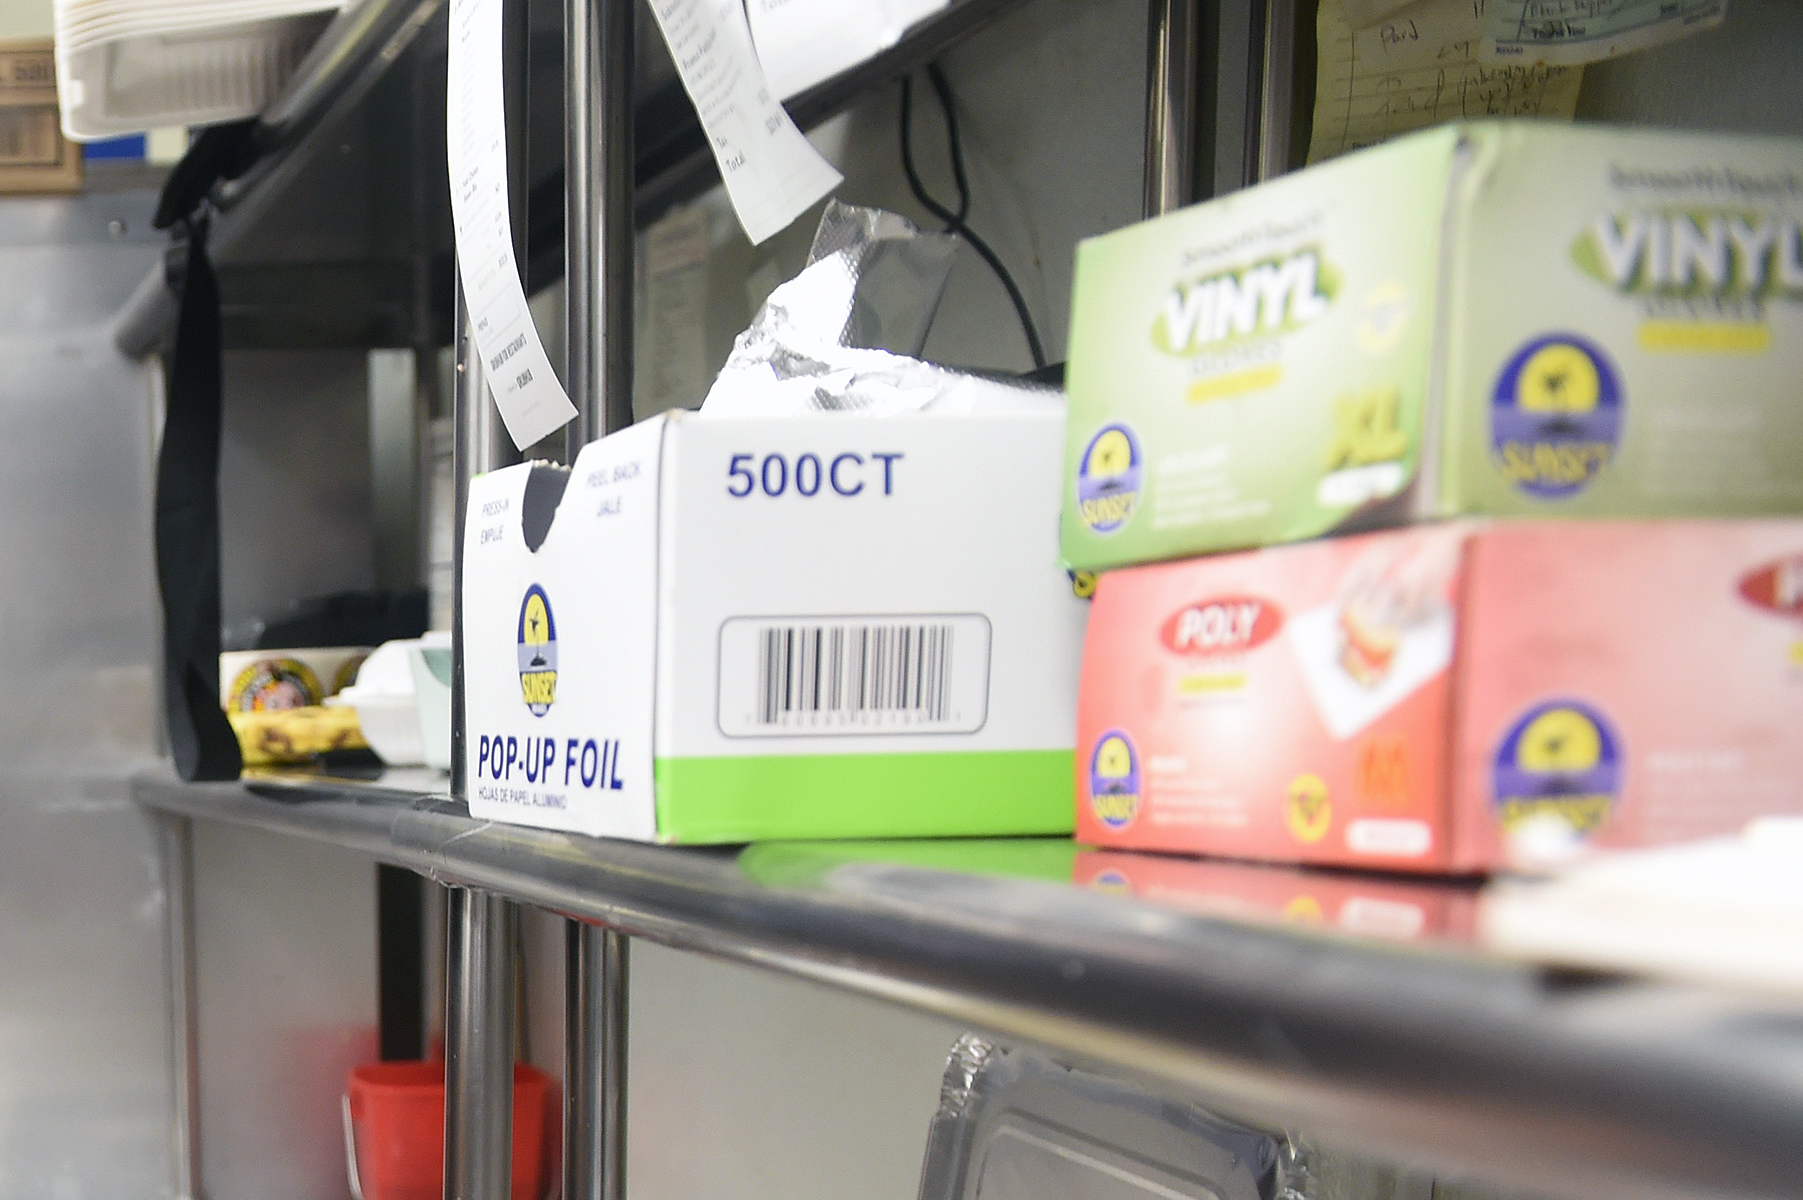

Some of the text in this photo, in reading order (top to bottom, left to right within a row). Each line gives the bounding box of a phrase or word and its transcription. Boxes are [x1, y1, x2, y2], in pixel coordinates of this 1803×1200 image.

[1164, 248, 1332, 352] VINYL
[727, 452, 905, 498] 500CT
[1173, 603, 1261, 649] POLY
[478, 734, 625, 791] POP-UP FOIL
[478, 785, 499, 802] HOJAS
[500, 787, 509, 802] DE
[509, 788, 530, 804] PAPEL
